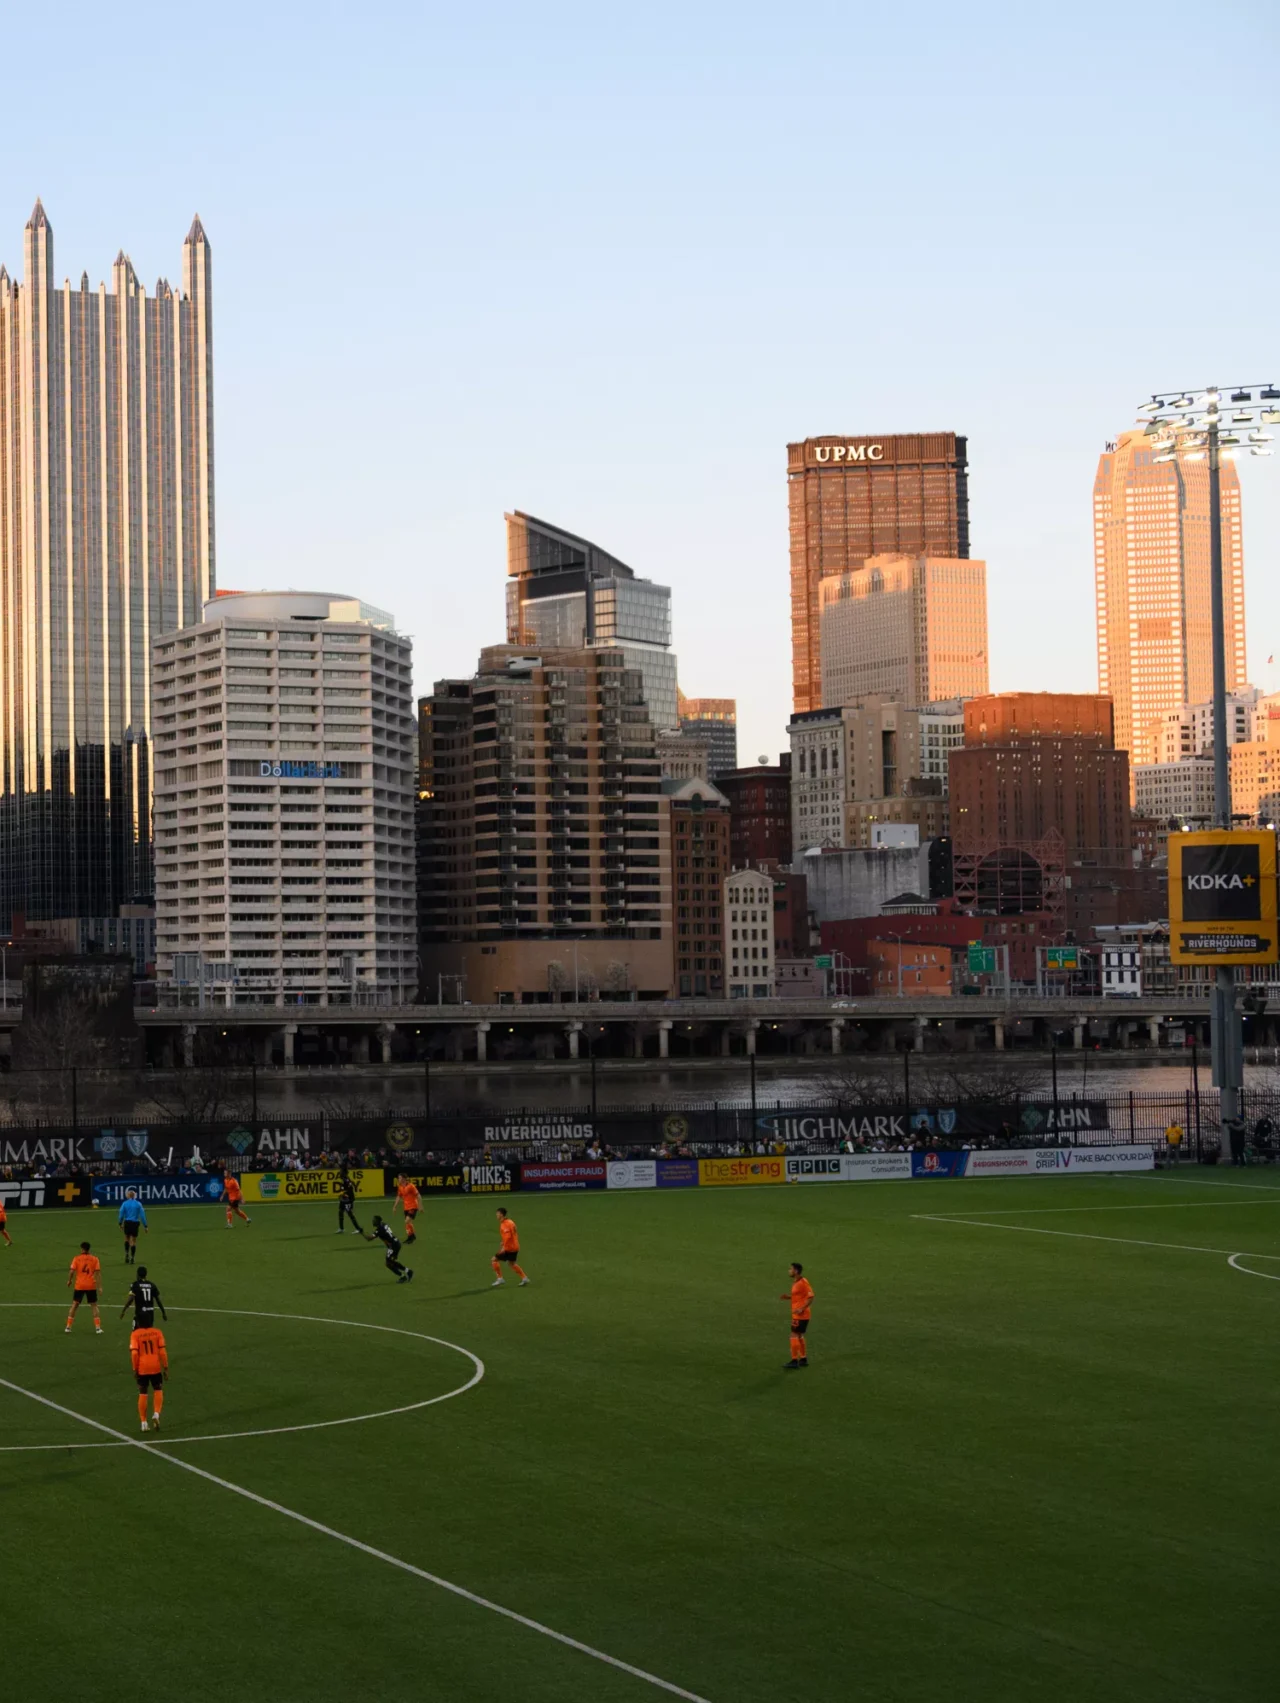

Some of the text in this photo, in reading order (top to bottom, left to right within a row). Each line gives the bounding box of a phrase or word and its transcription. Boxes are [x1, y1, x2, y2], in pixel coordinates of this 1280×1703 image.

[814, 445, 883, 462] UPMC
[1189, 939, 1257, 949] RIVERHOUNDS
[505, 1116, 573, 1125] PITTSBURGH
[1046, 1107, 1092, 1128] AHN
[484, 1124, 593, 1141] RIVERHOUNDS
[774, 1116, 905, 1140] HIGHMARK
[257, 1128, 310, 1151] AHN
[1035, 1151, 1054, 1159] QUICK
[1035, 1150, 1072, 1169] DRIP IV
[1074, 1152, 1153, 1163] TAKE BACK YOUR DAY
[789, 1159, 840, 1174] EPIC
[845, 1159, 877, 1167] Insurance
[878, 1158, 903, 1166] Brokers
[524, 1167, 603, 1178] INSURANCE FRAUD
[871, 1165, 910, 1174] Consultants
[286, 1170, 364, 1182] EVERY DA IS
[393, 1175, 461, 1187] MET ME AT
[286, 1181, 363, 1195] GAME DY.
[471, 1184, 492, 1192] BEER
[82, 1264, 89, 1275] 4
[141, 1288, 151, 1301] 11
[142, 1341, 154, 1354] 11
